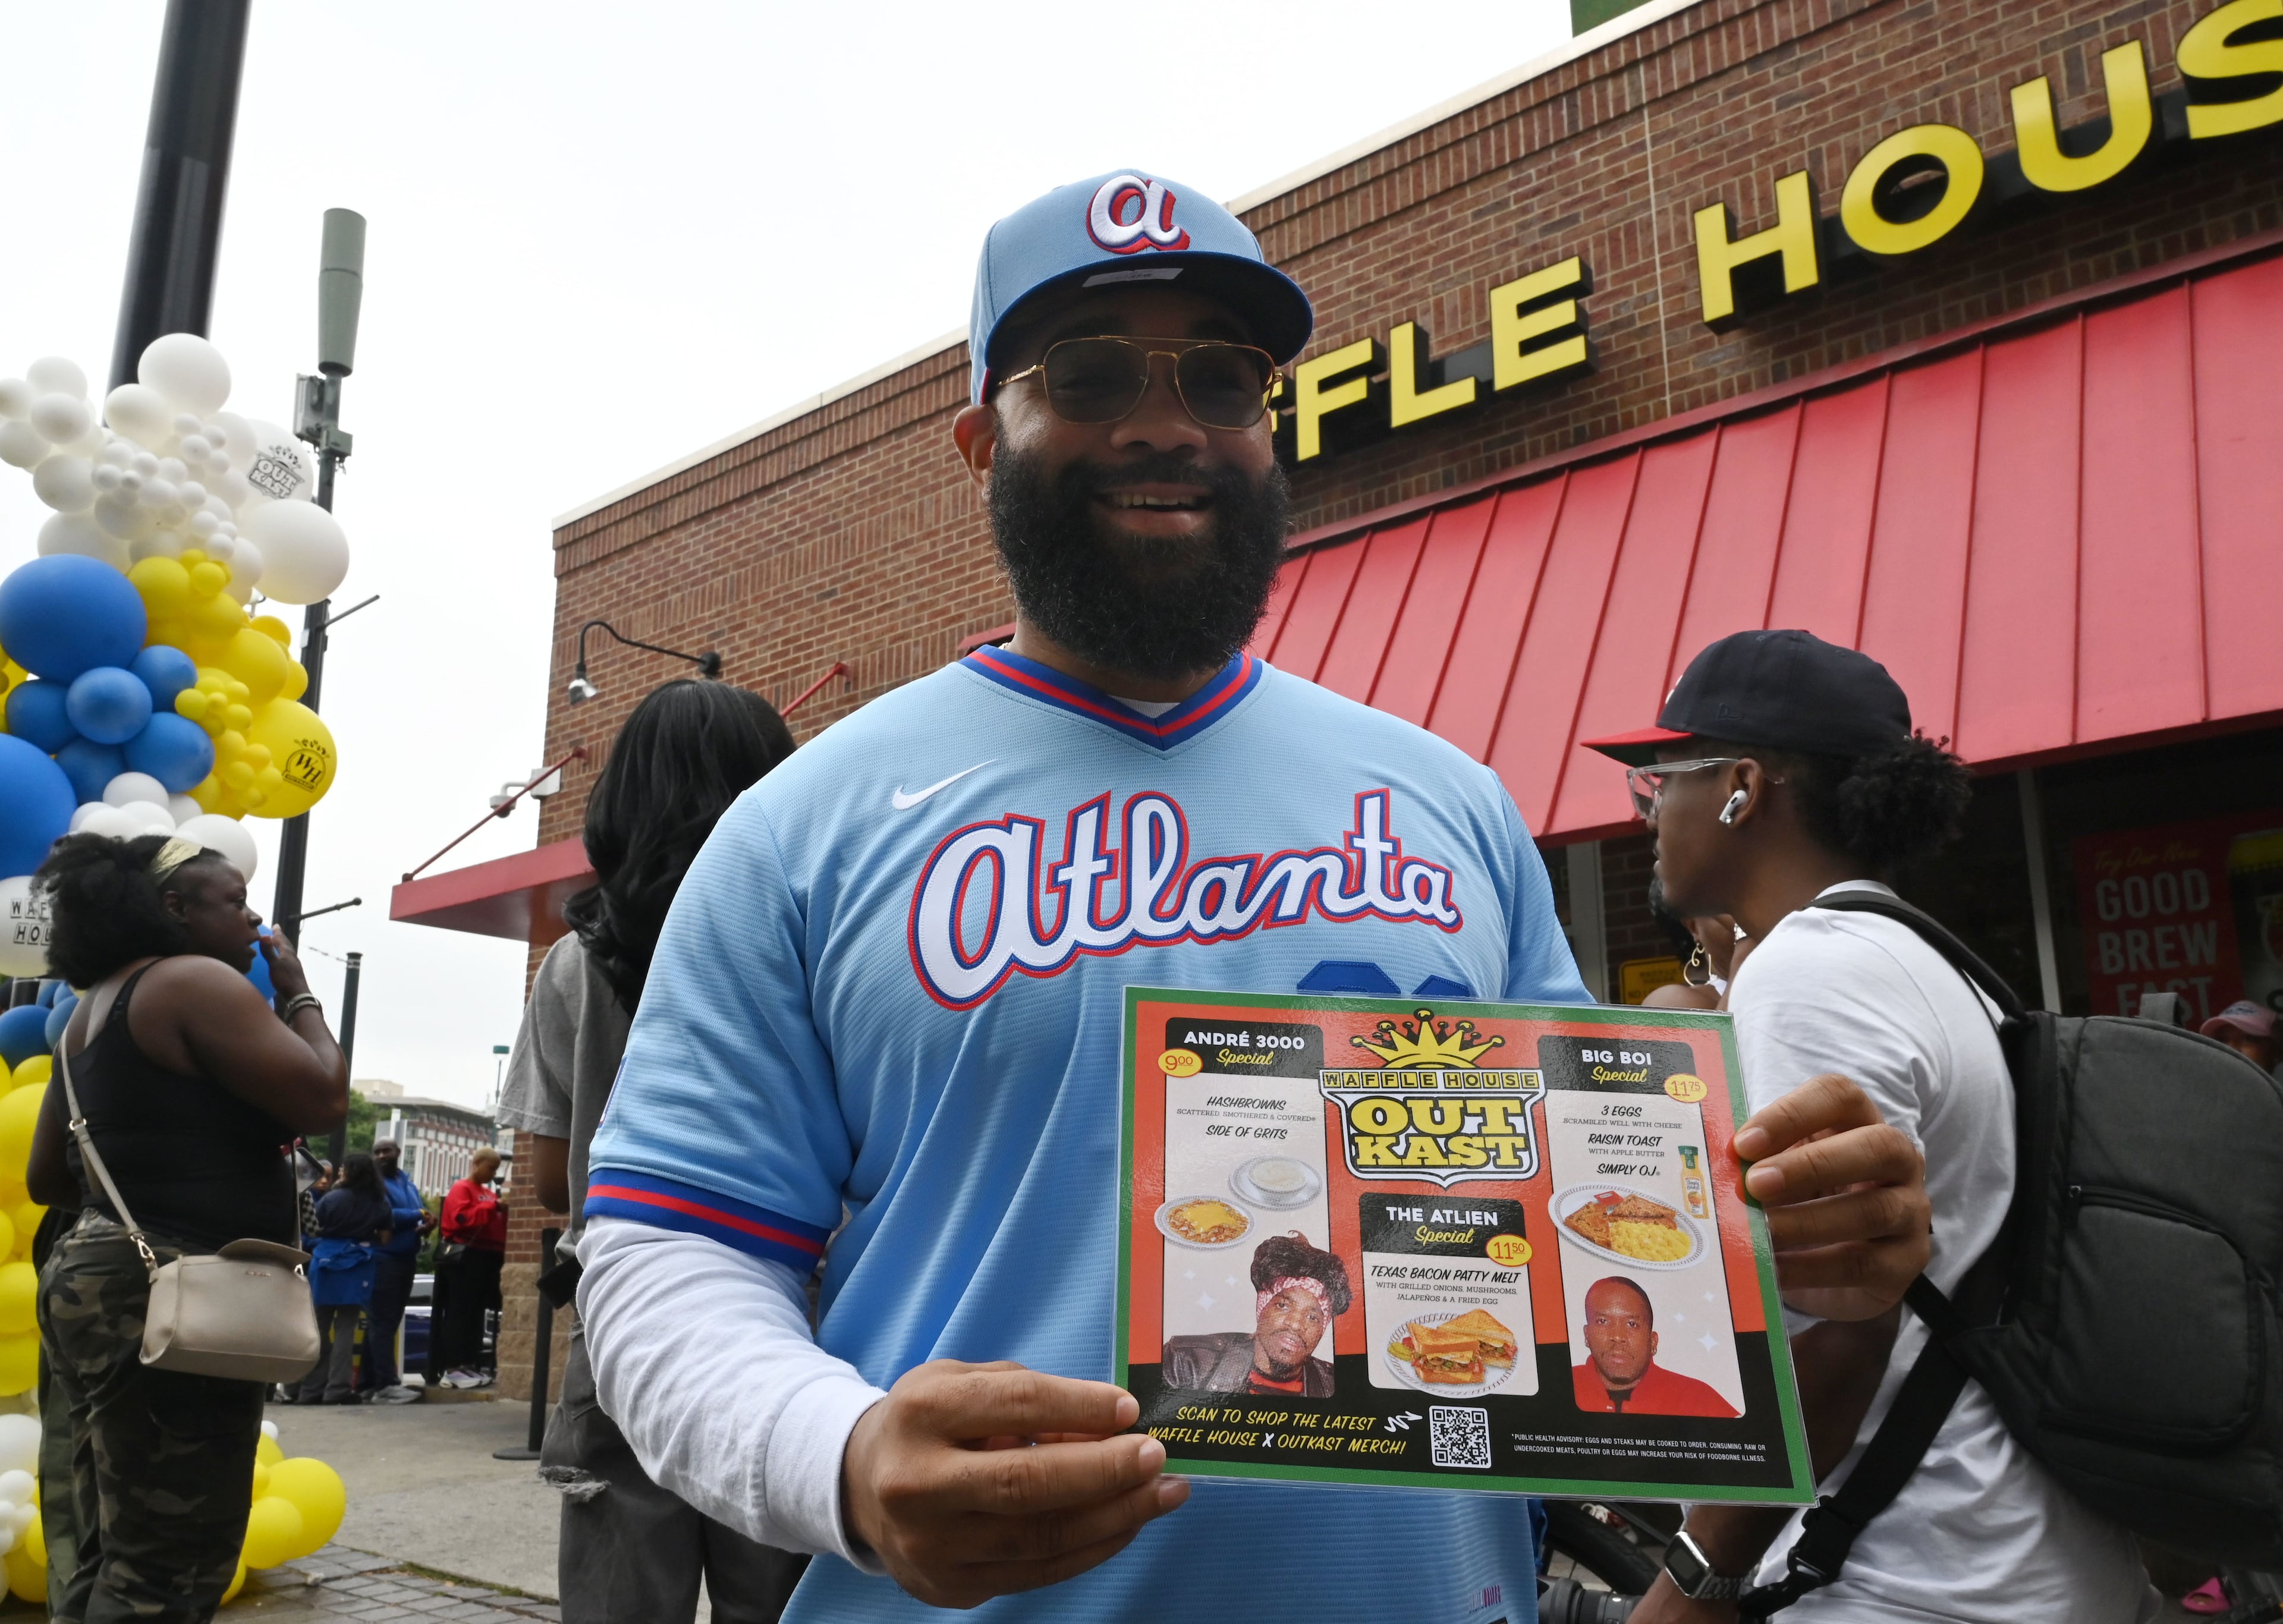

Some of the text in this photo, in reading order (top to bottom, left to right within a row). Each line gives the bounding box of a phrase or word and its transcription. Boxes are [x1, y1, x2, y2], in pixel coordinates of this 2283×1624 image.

[1264, 257, 1587, 462] FLE
[250, 469, 291, 499] KAST
[257, 459, 297, 491] OUT
[907, 787, 1464, 1011] Atlanta
[2095, 868, 2211, 922] GOOD
[2098, 920, 2218, 975] BREW
[1183, 1031, 1306, 1050] ANDRÉ 3000
[1216, 1048, 1273, 1066] Special
[1581, 1049, 1652, 1065] BIG BOI
[1325, 1073, 1537, 1087] WAFFLE HOUSE
[1590, 1065, 1647, 1085] Special
[1207, 1096, 1287, 1110] HASHBROWNS
[1601, 1105, 1642, 1117] 3 EGGS
[1177, 1109, 1221, 1117] SCATTERED,
[1222, 1111, 1268, 1119] SMOTHERED
[1350, 1098, 1522, 1135] OUT
[1206, 1124, 1288, 1140] SIDE OF GRITS
[1588, 1134, 1663, 1147] RAISIN TOAST
[1354, 1135, 1527, 1167] KAST
[1597, 1163, 1637, 1175] SIMPLY
[1386, 1206, 1498, 1226] THE ATLIEN
[1414, 1225, 1474, 1246] Special
[1370, 1265, 1521, 1283] TEXAS BACON PATTY MELT
[1397, 1293, 1441, 1302] JALAPEÑOS
[1466, 1286, 1518, 1295] MUSHROOMS,
[1175, 1405, 1376, 1431] SCAN TO SHOP THE LATEST
[1147, 1426, 1203, 1443] WAFFLE
[1207, 1430, 1259, 1446] HOUSE
[1277, 1433, 1345, 1451] OUTKAST
[1347, 1439, 1407, 1455] MERCH!
[1556, 1435, 1584, 1443] ADVISORY:
[1709, 1442, 1742, 1450] CONSUMING
